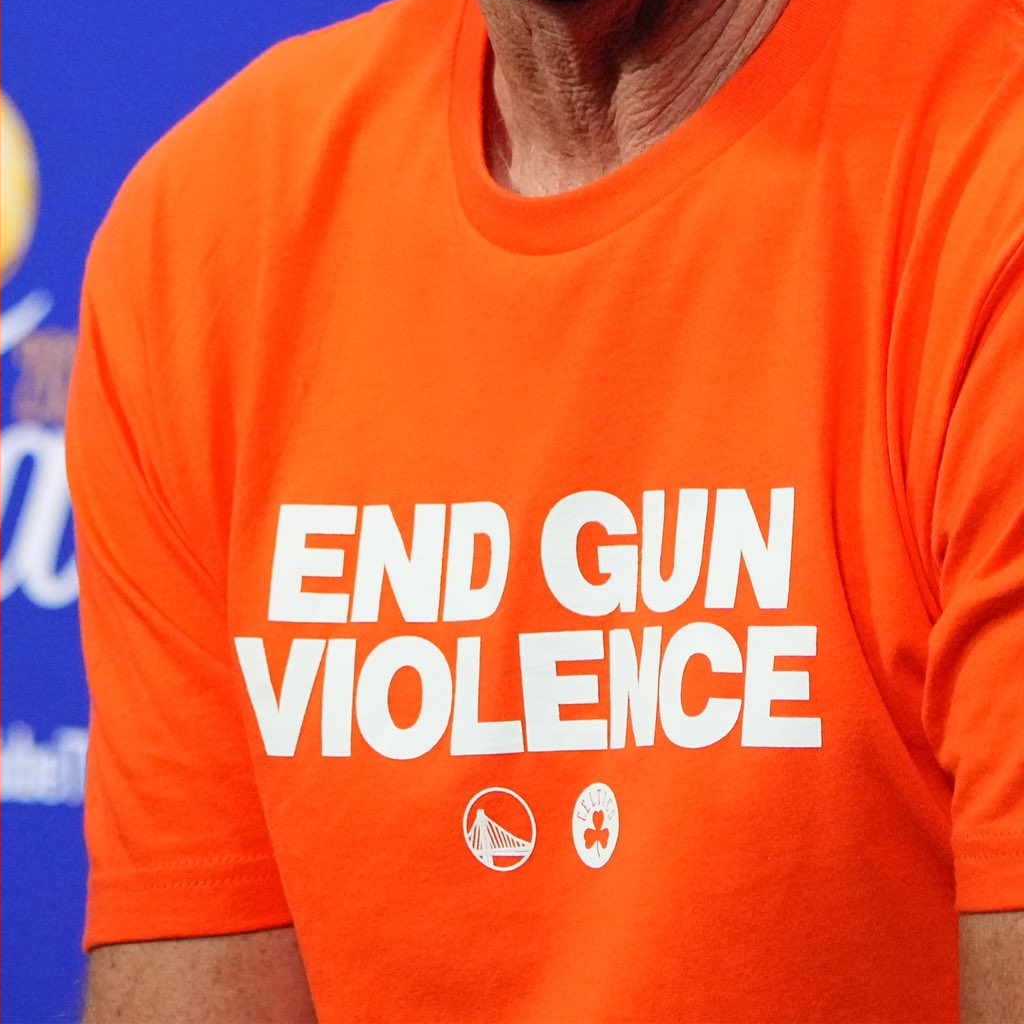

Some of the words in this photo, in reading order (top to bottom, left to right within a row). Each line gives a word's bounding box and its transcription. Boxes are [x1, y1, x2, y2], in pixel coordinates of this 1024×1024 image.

[268, 501, 510, 623] END
[540, 487, 795, 617] GUN
[234, 622, 823, 760] VIOLENCE
[576, 788, 616, 822] CELTICS
